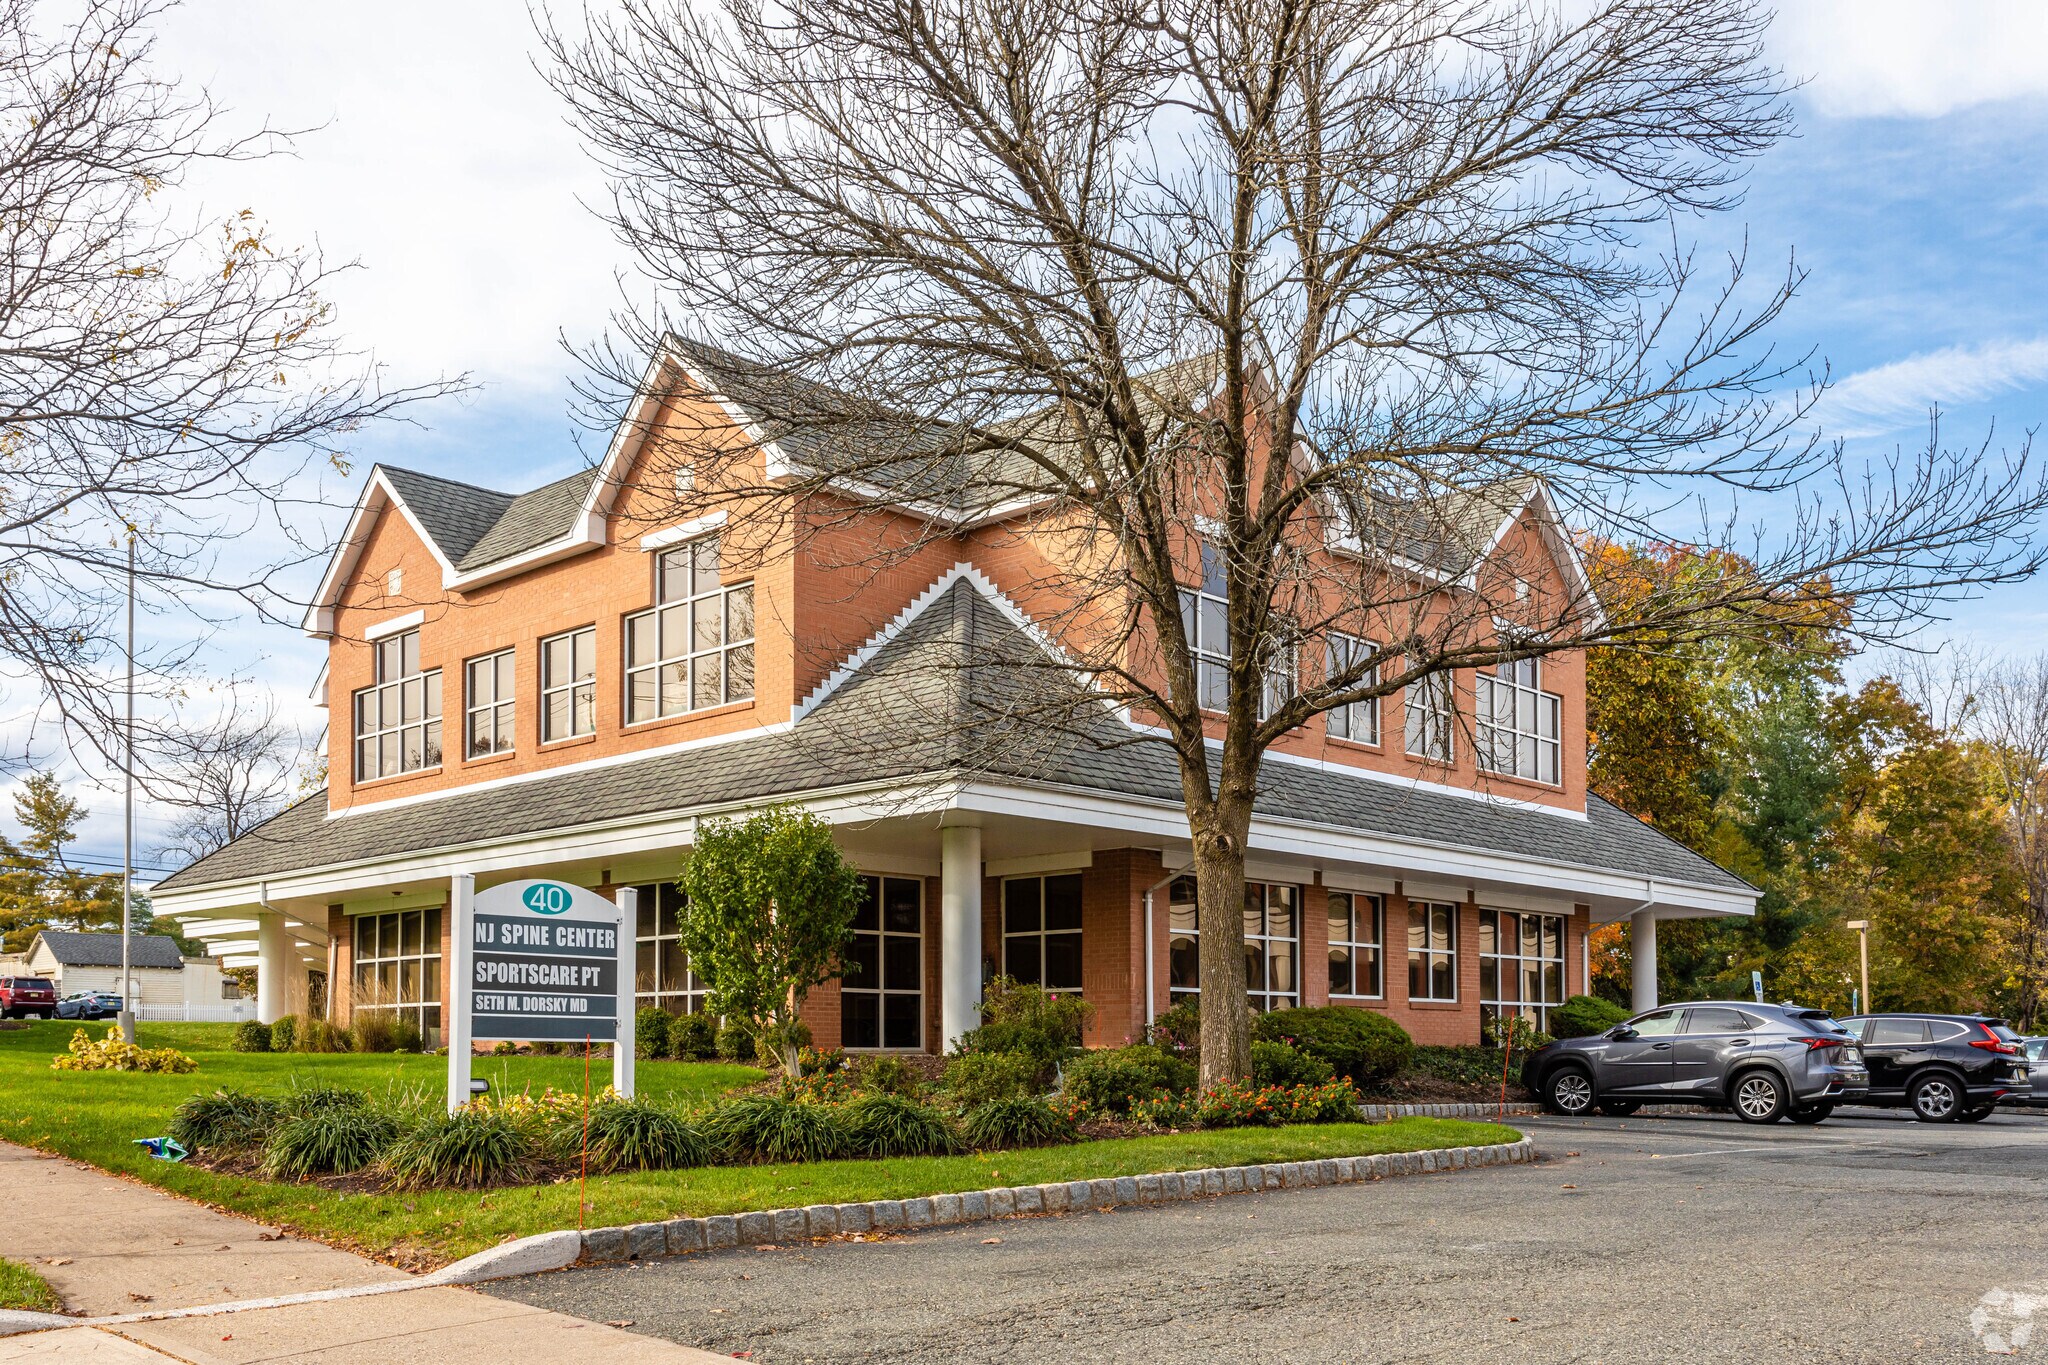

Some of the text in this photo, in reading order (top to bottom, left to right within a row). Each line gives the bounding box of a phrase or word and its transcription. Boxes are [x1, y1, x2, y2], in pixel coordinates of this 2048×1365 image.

[530, 886, 564, 912] 40
[475, 922, 615, 949] NJ SPINE CENTER
[476, 961, 601, 987] SPORTSCARE PT
[475, 994, 588, 1013] SETH M. DORSKY MD
